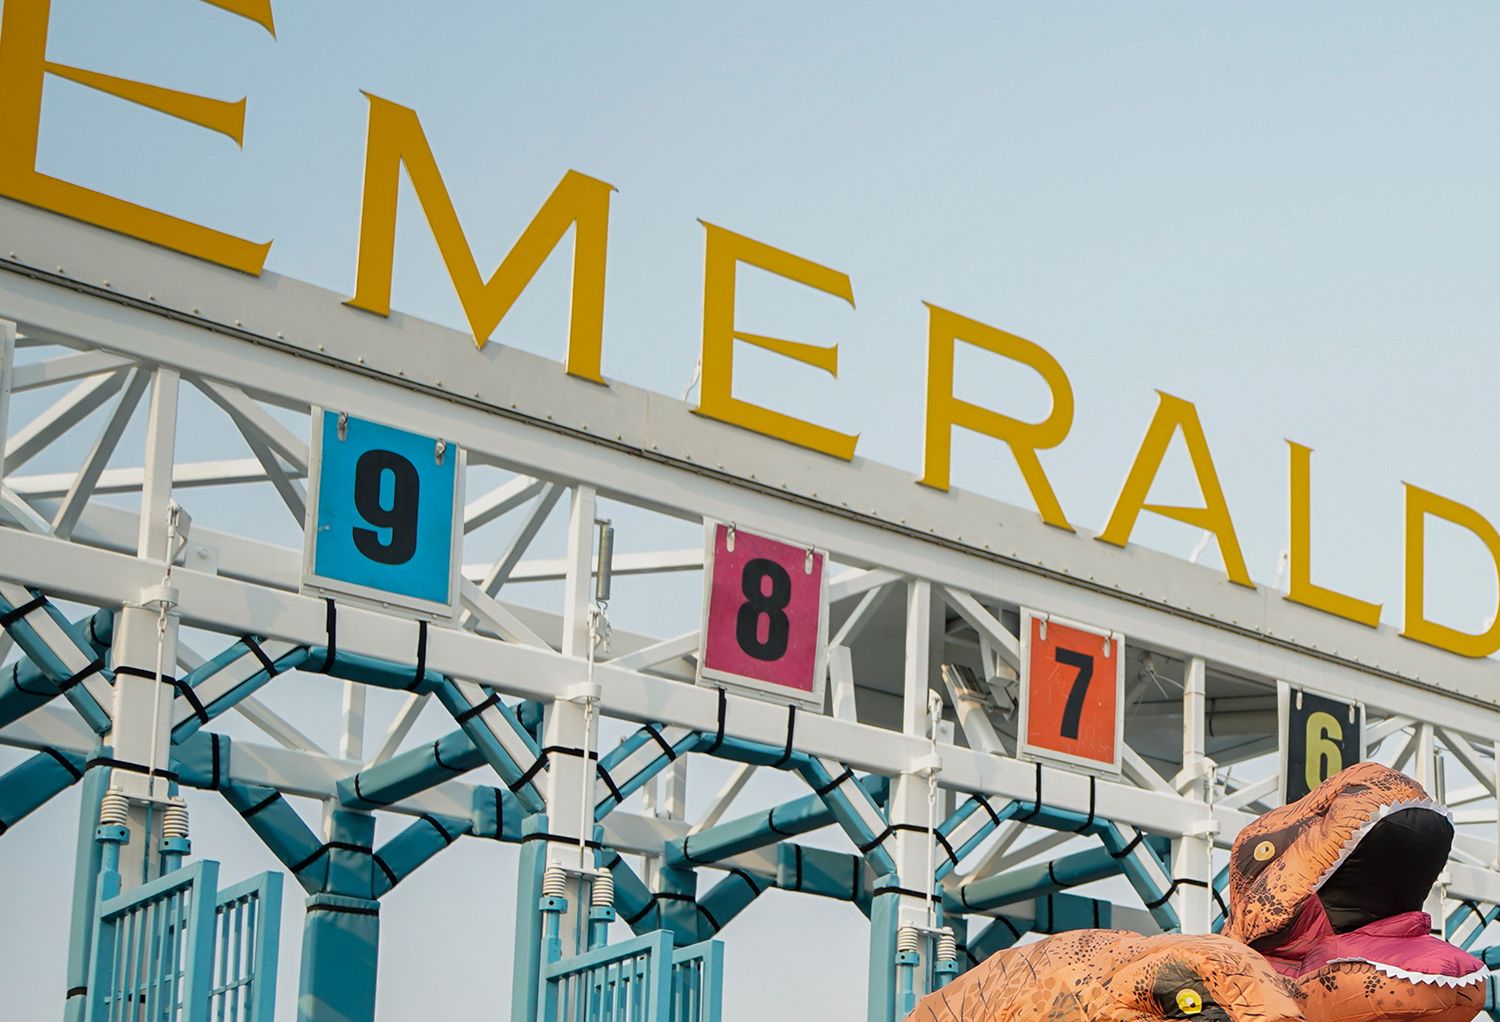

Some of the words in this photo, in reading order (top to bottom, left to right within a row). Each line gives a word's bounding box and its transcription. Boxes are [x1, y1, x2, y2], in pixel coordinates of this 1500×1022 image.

[353, 449, 421, 566] 9
[734, 558, 792, 663] 8
[1052, 646, 1095, 741] 7
[1305, 711, 1344, 792] 6
